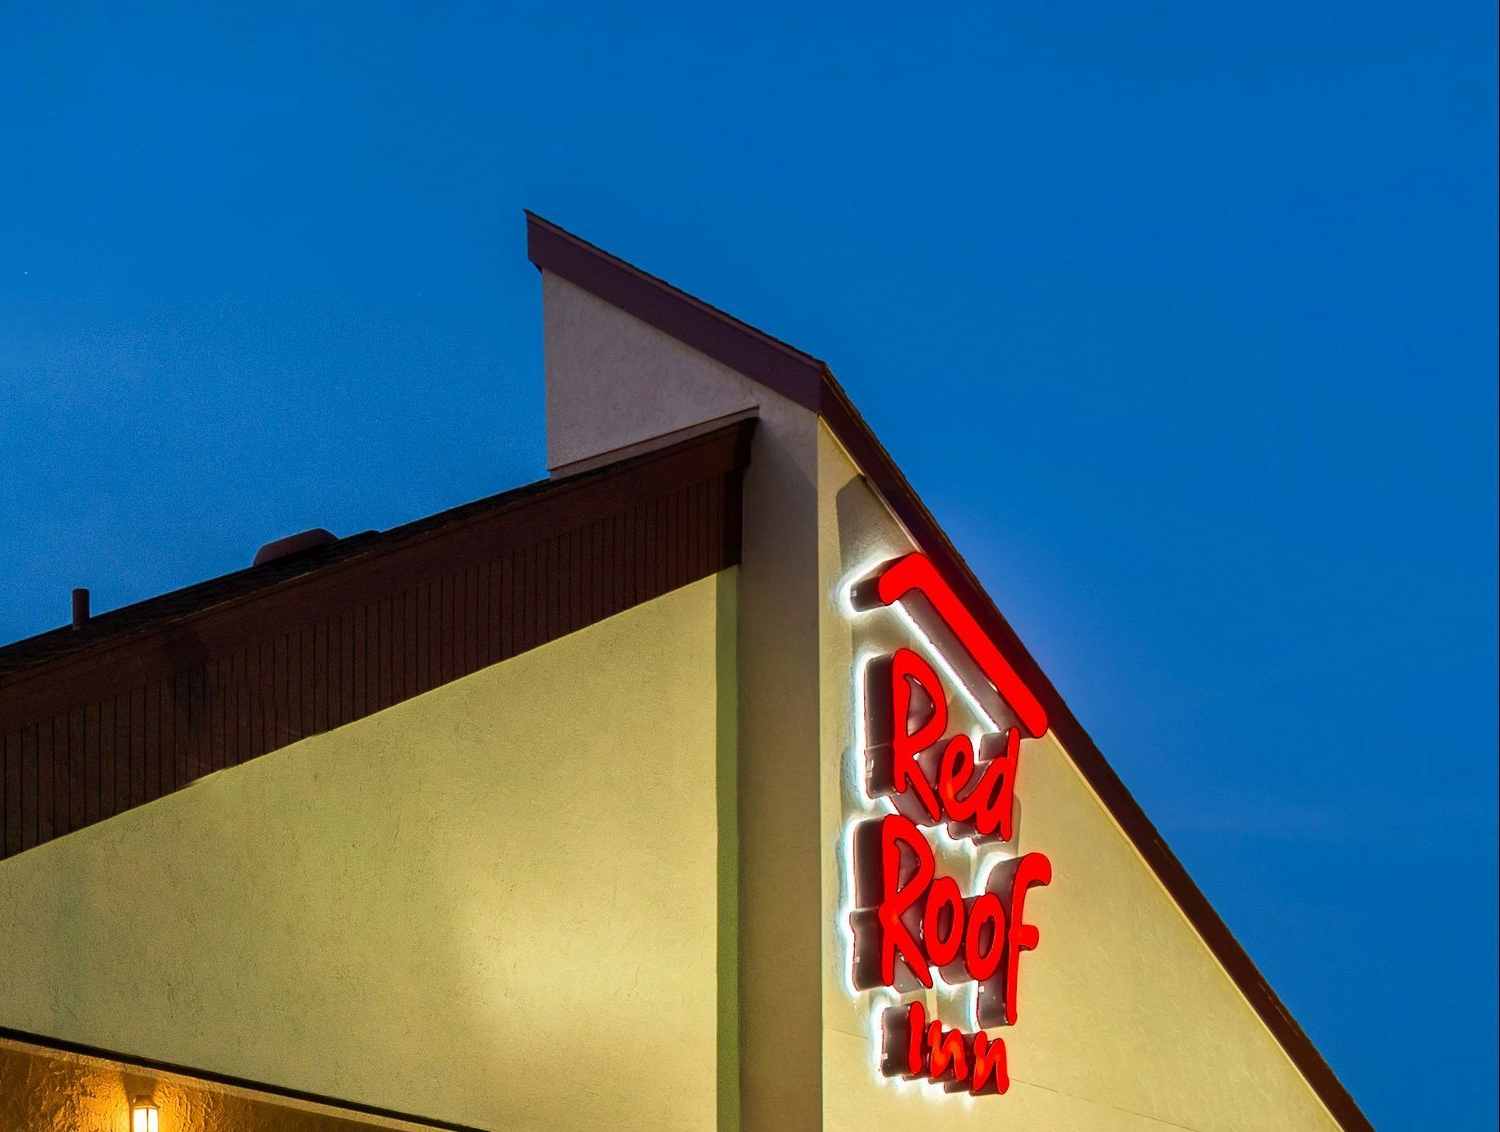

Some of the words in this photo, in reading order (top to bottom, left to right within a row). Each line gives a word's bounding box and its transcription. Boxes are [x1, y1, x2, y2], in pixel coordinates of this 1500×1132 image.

[893, 647, 1021, 842] Red
[878, 814, 1052, 1026] Roof
[908, 1000, 1010, 1094] Inn
